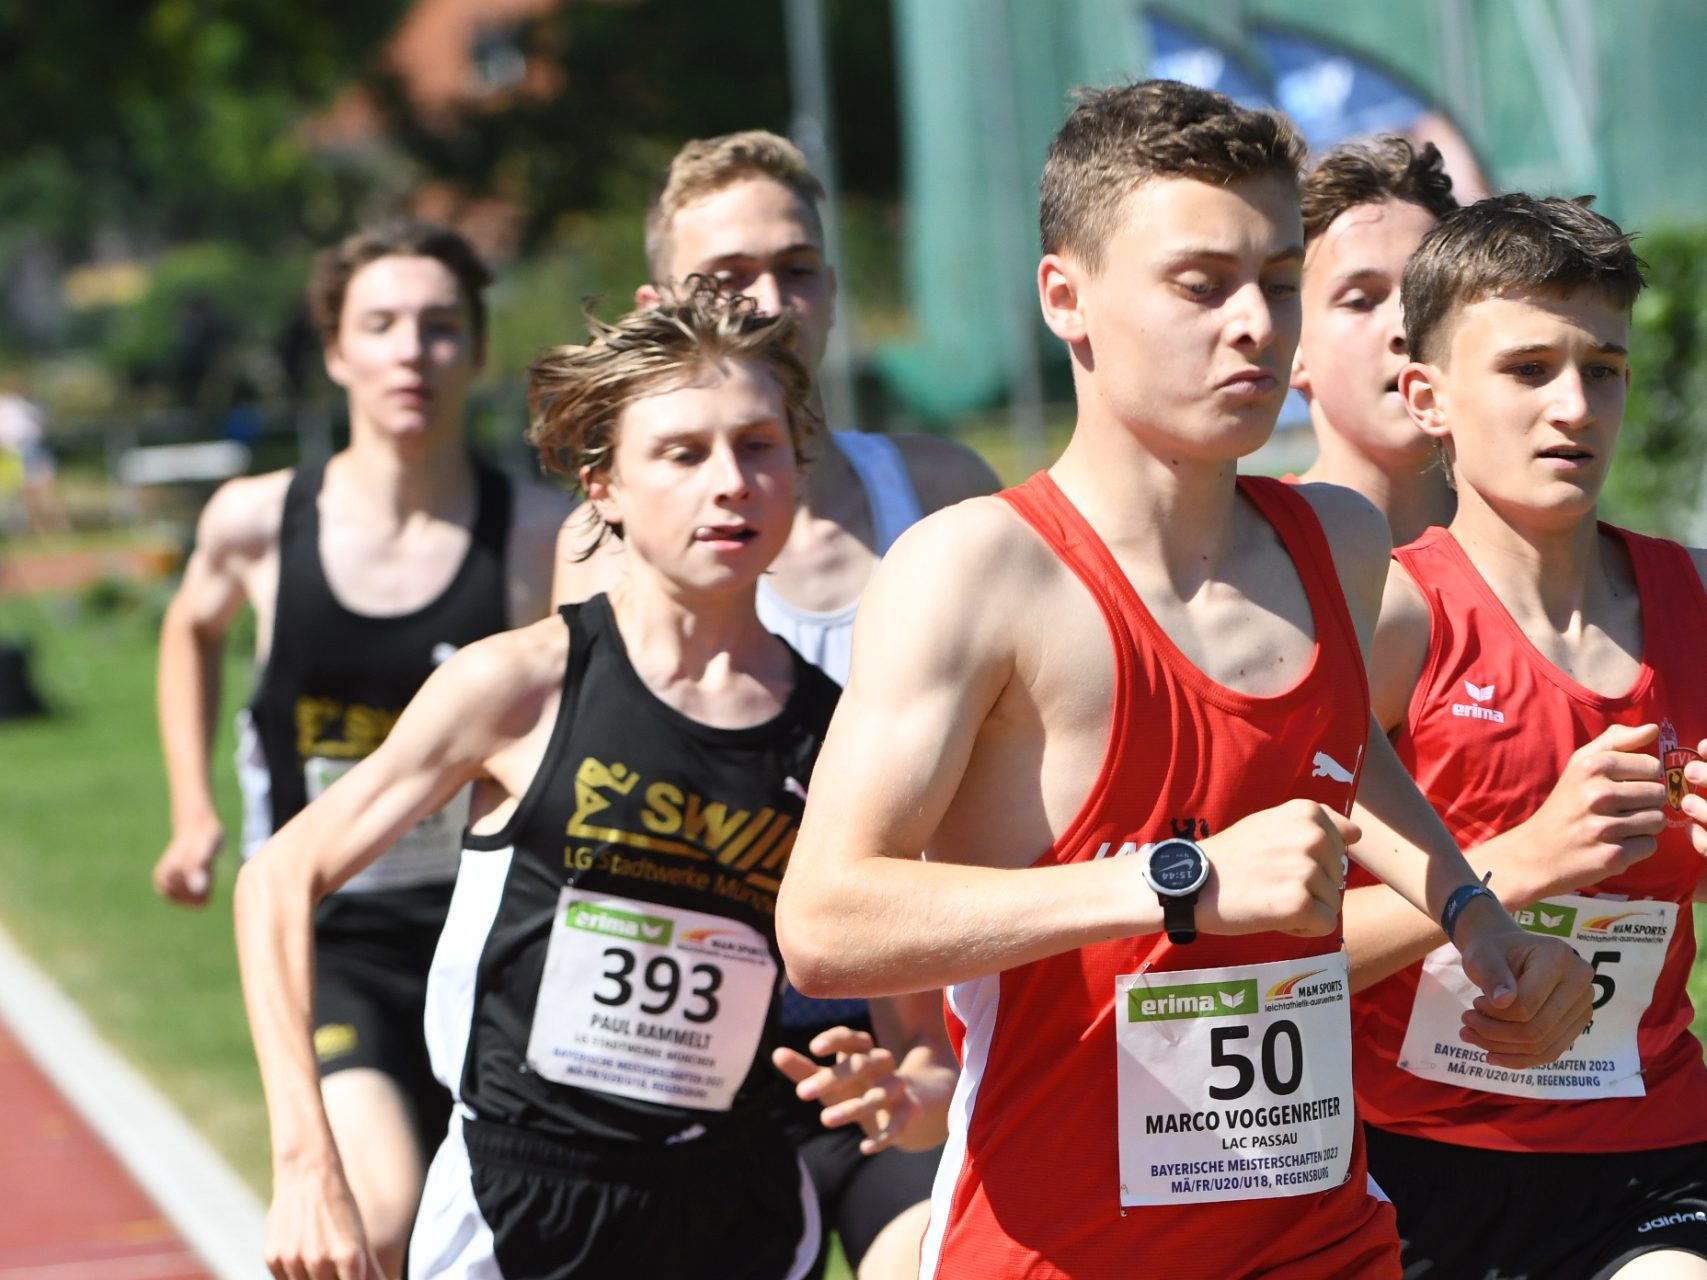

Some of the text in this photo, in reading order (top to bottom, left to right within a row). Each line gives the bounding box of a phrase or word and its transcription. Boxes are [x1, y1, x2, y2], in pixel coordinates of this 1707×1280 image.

[1452, 703, 1504, 723] erima
[563, 846, 594, 870] LG
[598, 852, 711, 889] Stadtwerke
[575, 908, 639, 937] erima
[1633, 924, 1667, 936] SPORTS
[593, 947, 724, 1024] 393
[1297, 980, 1343, 998] M&M SPORTS
[1141, 993, 1216, 1016] erima
[590, 1013, 713, 1049] PAUL RAMMELT
[1208, 1019, 1304, 1101] 50
[1434, 1043, 1489, 1064] BAYERISC
[1589, 1060, 1616, 1072] 2023
[1447, 1062, 1601, 1087] MÄ/FR/U20/U18, REGENSBURG
[1145, 1096, 1341, 1135] MARCO VOGGENREITER
[1222, 1132, 1298, 1150] LAC PASSAU
[1151, 1147, 1339, 1177] BAYERISCHE MEISTERSCHAFTEN 2023
[1171, 1166, 1329, 1194] MÄ/FR/U20/U18, REGENSBURG
